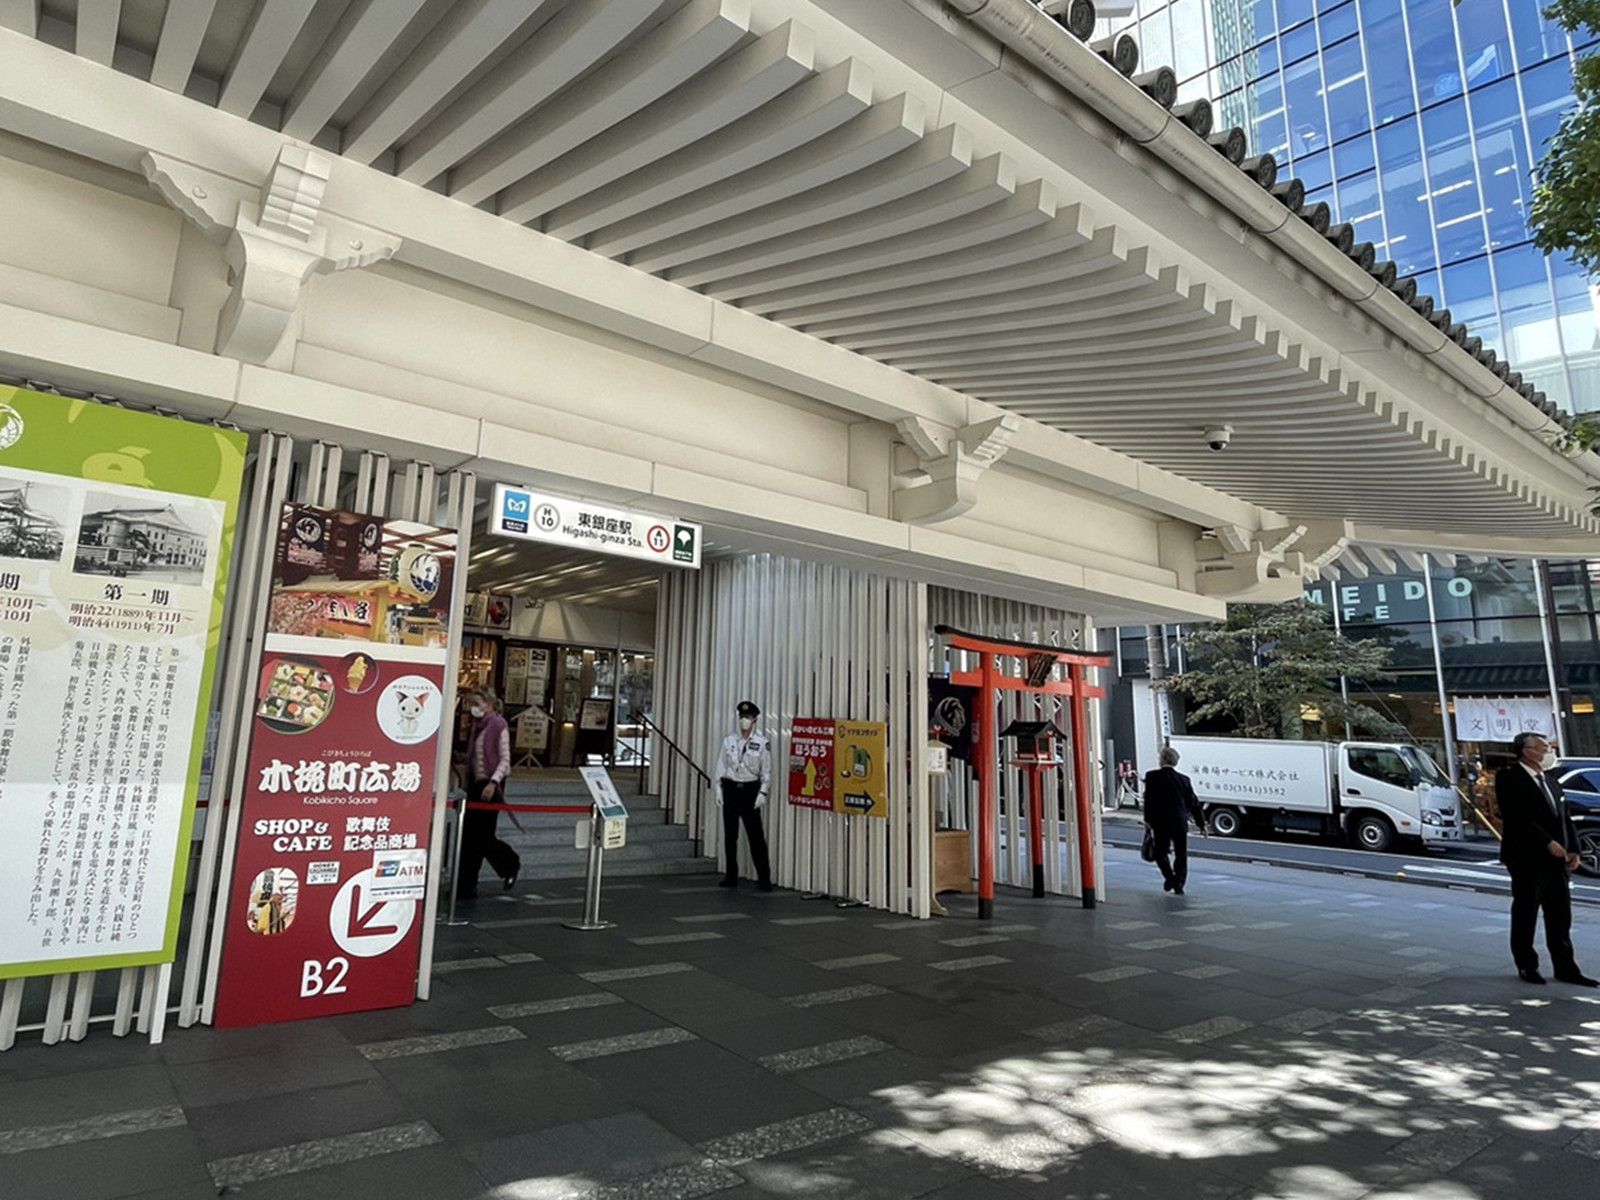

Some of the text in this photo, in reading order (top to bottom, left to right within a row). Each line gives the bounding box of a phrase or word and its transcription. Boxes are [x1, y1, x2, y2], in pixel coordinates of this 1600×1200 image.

[543, 508, 552, 517] H
[541, 516, 555, 528] 10
[577, 512, 633, 536] 東銀座駅
[562, 525, 645, 548] Higashi-ginza Sta.
[655, 530, 663, 538] A
[653, 537, 664, 547] 11
[104, 583, 170, 606] 第一期
[1471, 718, 1540, 732] 文明堂
[795, 744, 828, 758] ほうおう
[258, 759, 423, 794] 木挽町広場
[303, 796, 379, 805] Kobikicho Square
[346, 816, 391, 833] 歌舞伎
[273, 836, 333, 853] CAFE
[399, 865, 424, 877] ATM
[300, 956, 349, 998] B2
